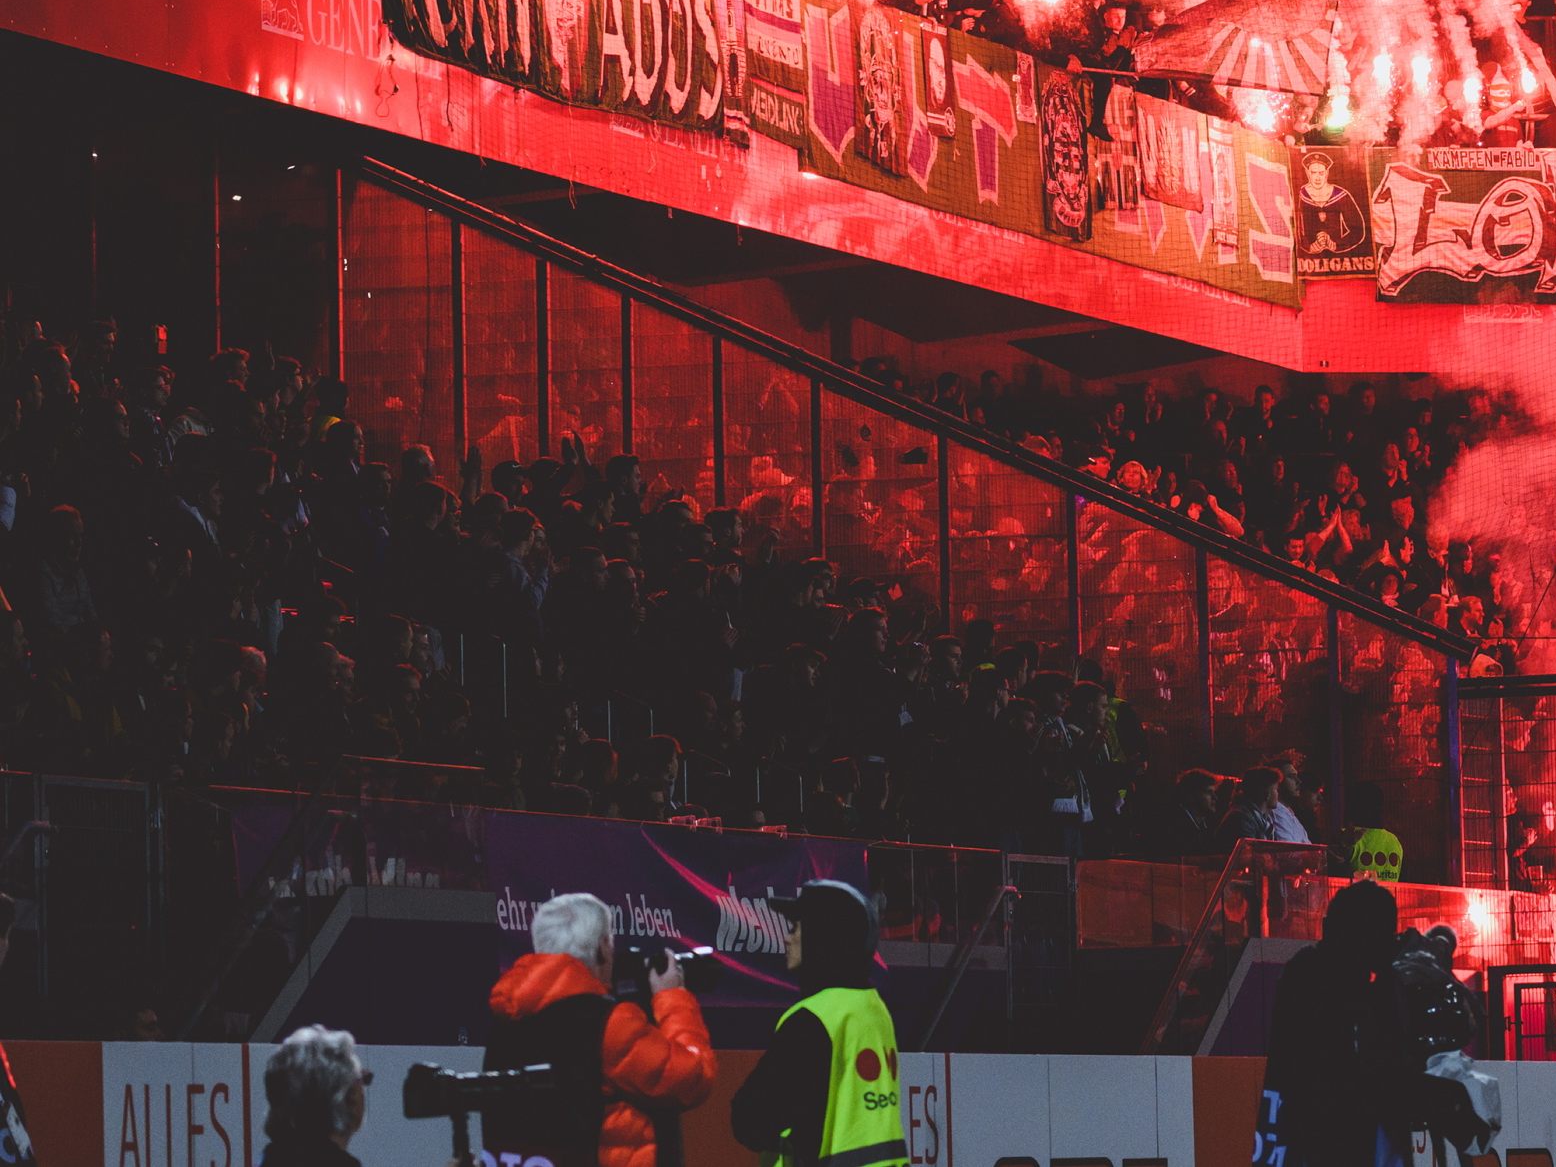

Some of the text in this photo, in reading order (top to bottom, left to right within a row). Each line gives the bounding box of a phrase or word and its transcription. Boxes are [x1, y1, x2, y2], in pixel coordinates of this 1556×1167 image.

[1500, 150, 1535, 168] FABIO
[1297, 258, 1374, 273] OOLIGANS
[626, 893, 682, 938] leben.
